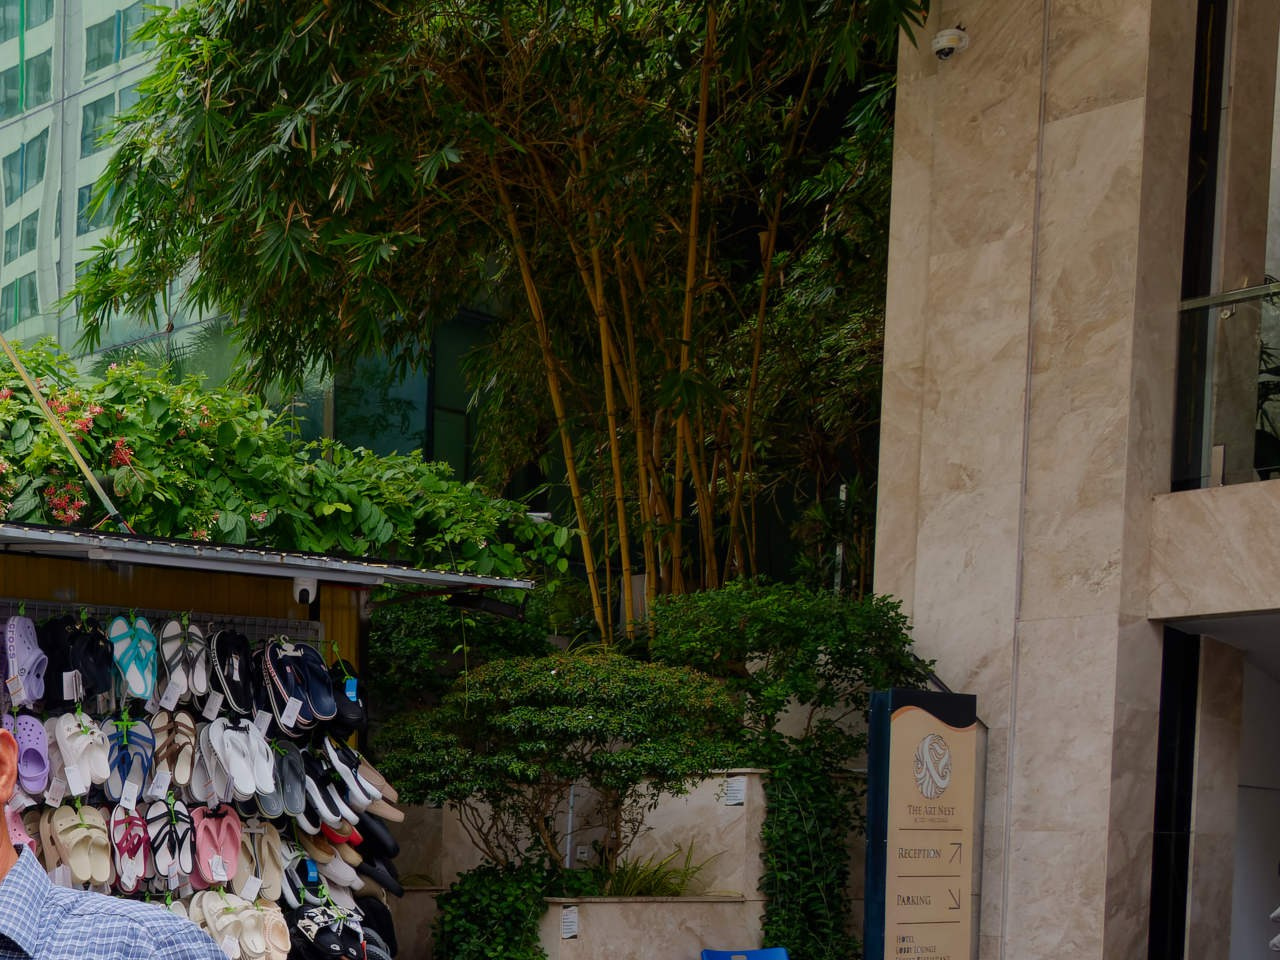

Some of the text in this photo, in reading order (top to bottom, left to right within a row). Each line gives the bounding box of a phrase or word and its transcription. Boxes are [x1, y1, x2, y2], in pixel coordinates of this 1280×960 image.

[907, 804, 956, 816] THE ART NEST
[897, 847, 942, 859] RECEPTION
[896, 894, 932, 906] PARKING
